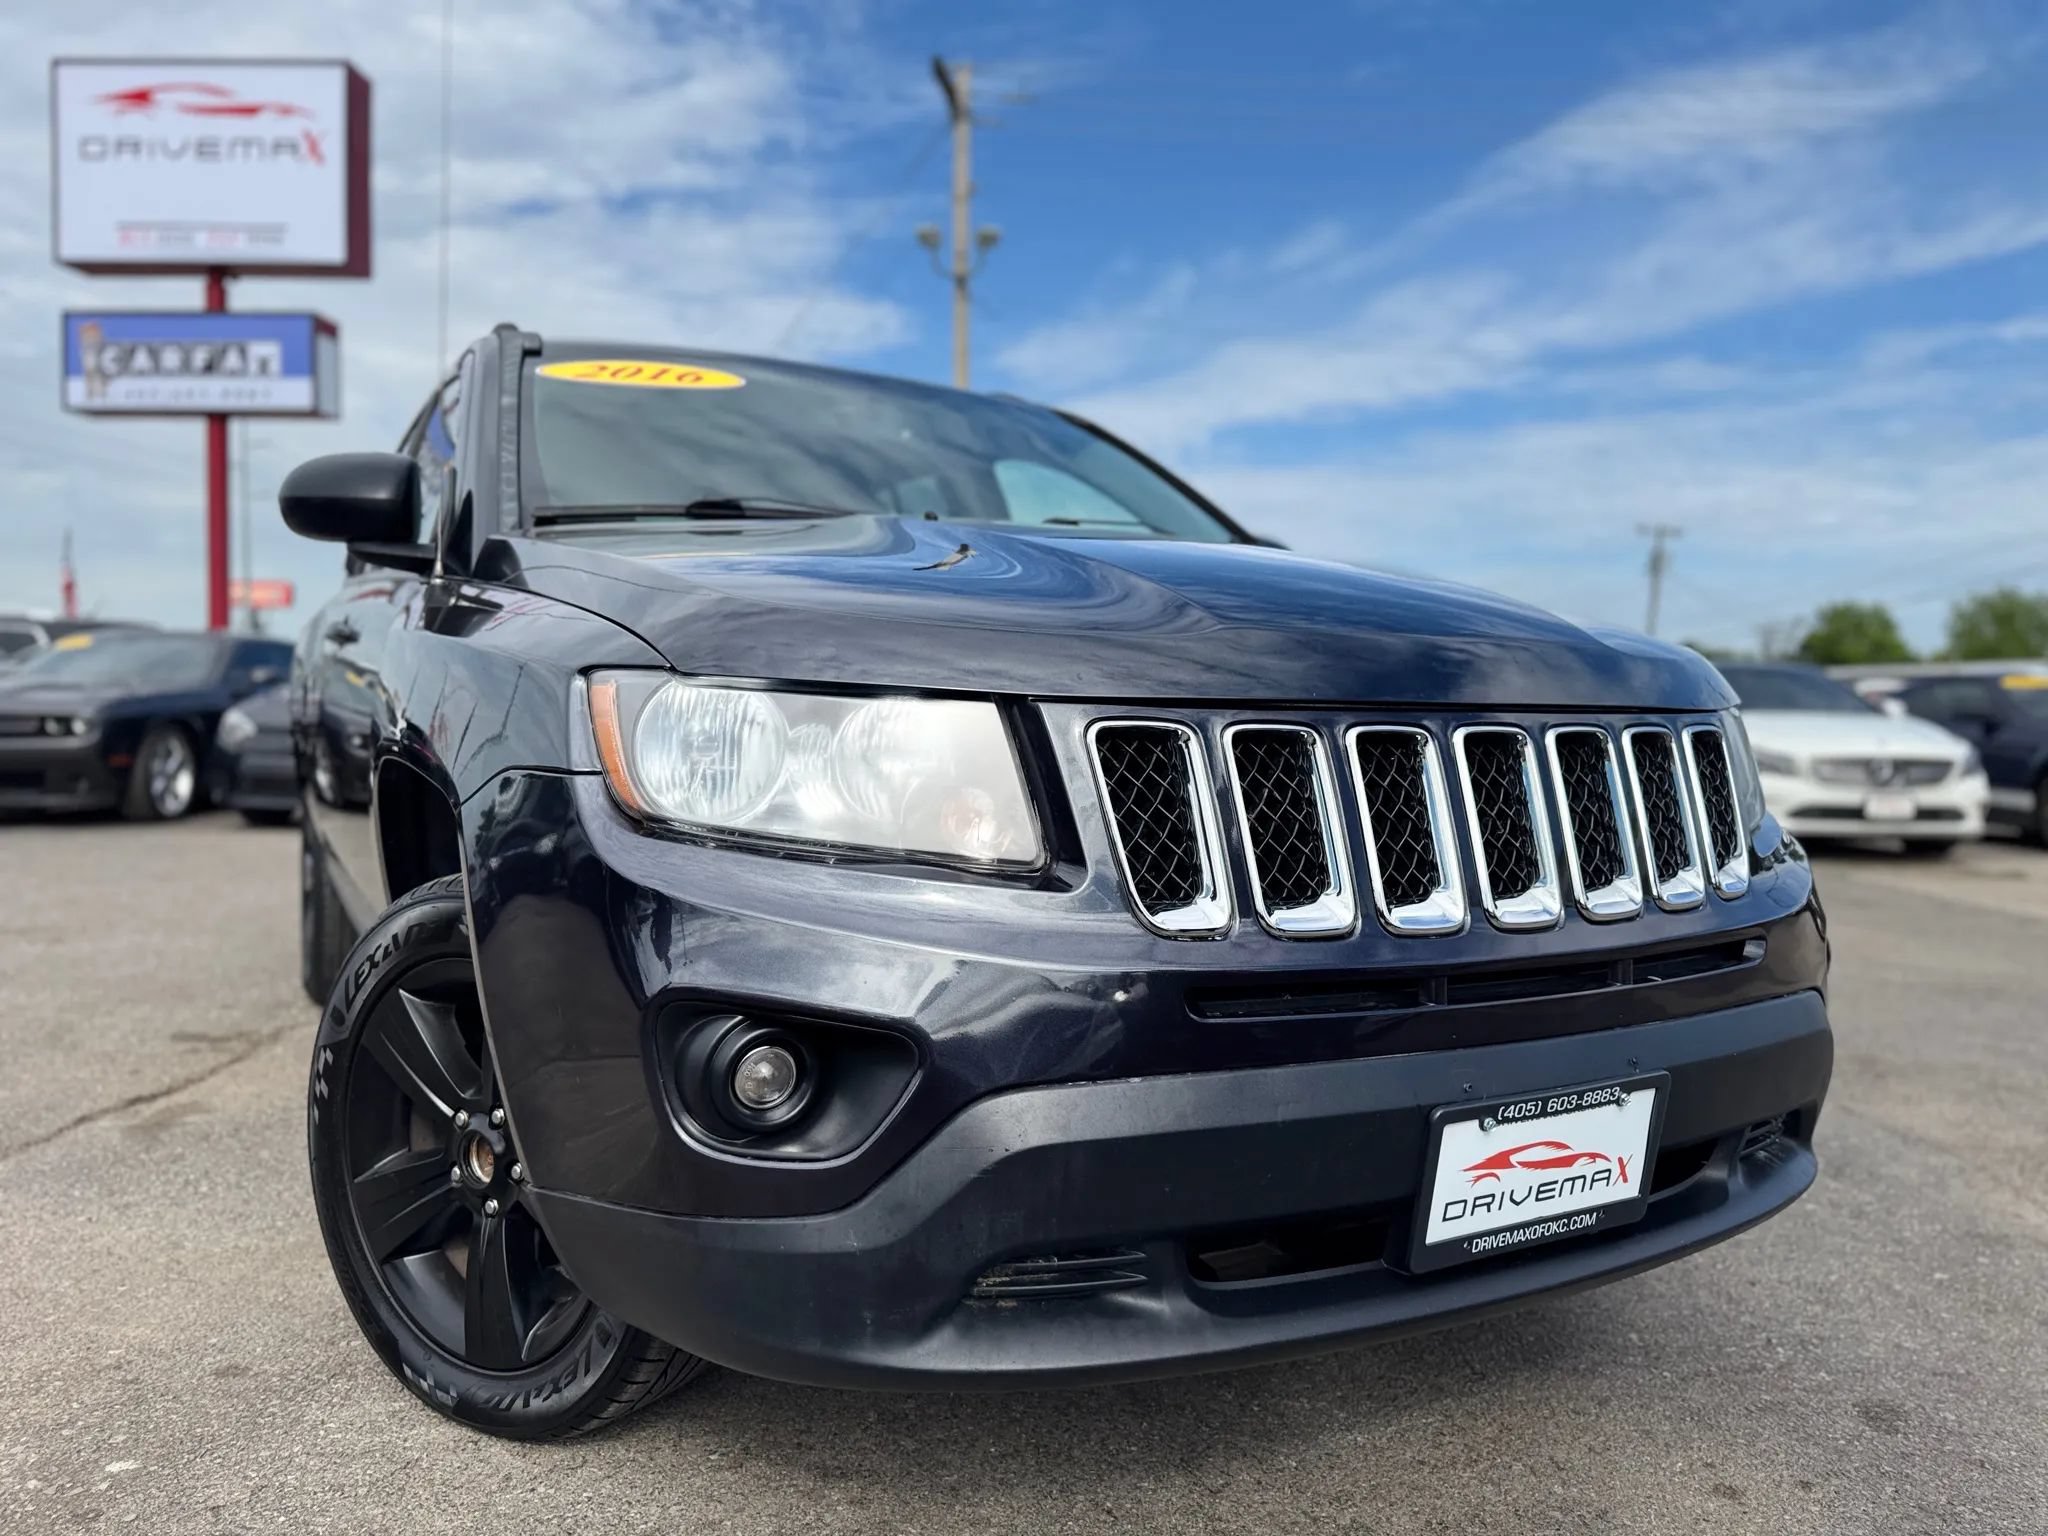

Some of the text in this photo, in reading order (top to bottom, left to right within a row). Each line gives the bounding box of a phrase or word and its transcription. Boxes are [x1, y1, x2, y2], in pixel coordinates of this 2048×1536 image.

[77, 128, 328, 166] DRIVEMAX
[574, 364, 704, 384] 2016
[343, 920, 440, 1014] LEXAN
[1497, 1100, 1542, 1120] (405)
[1546, 1086, 1620, 1113] 603-8883
[1441, 1153, 1634, 1223] DRIVEMAX
[1471, 1212, 1597, 1254] DRIVEMAXOFOKC.COM
